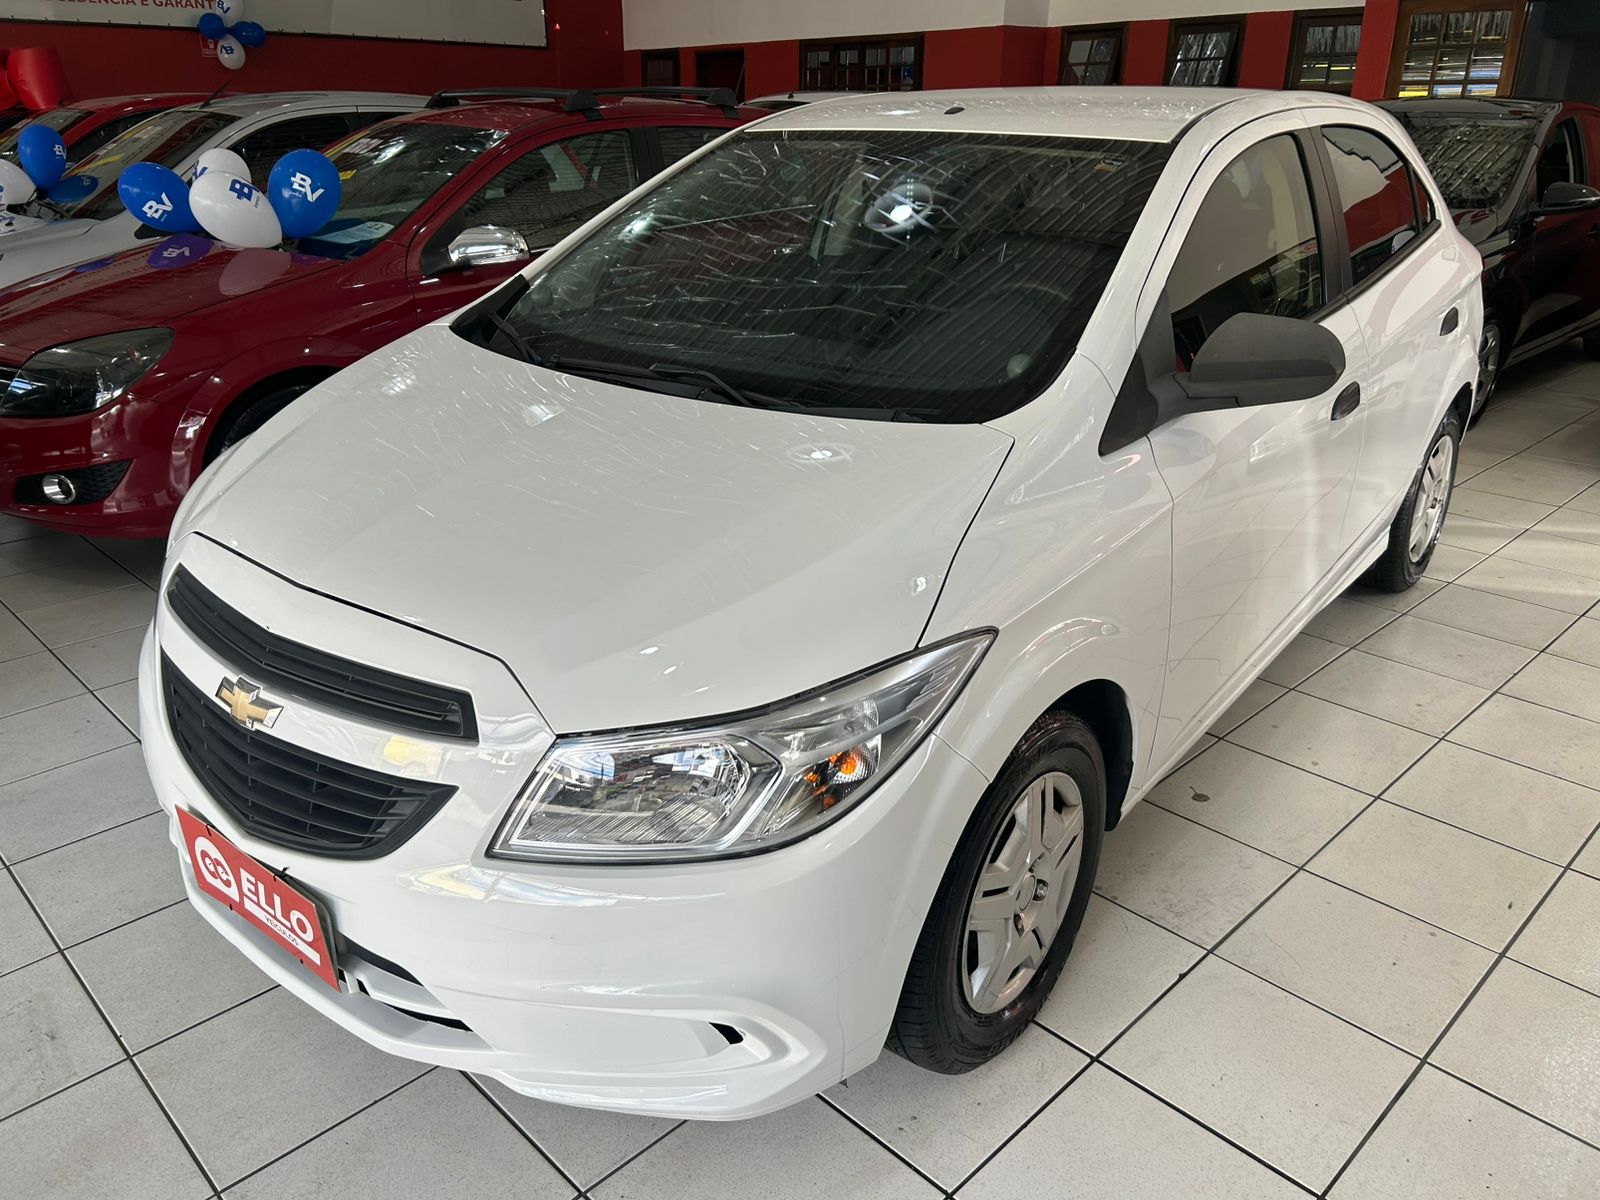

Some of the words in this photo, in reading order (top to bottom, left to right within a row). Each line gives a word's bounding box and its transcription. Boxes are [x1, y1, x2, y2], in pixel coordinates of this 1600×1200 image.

[152, 0, 217, 10] GARANT
[290, 172, 325, 202] BV
[142, 192, 173, 219] BV
[239, 866, 314, 943] ELLO
